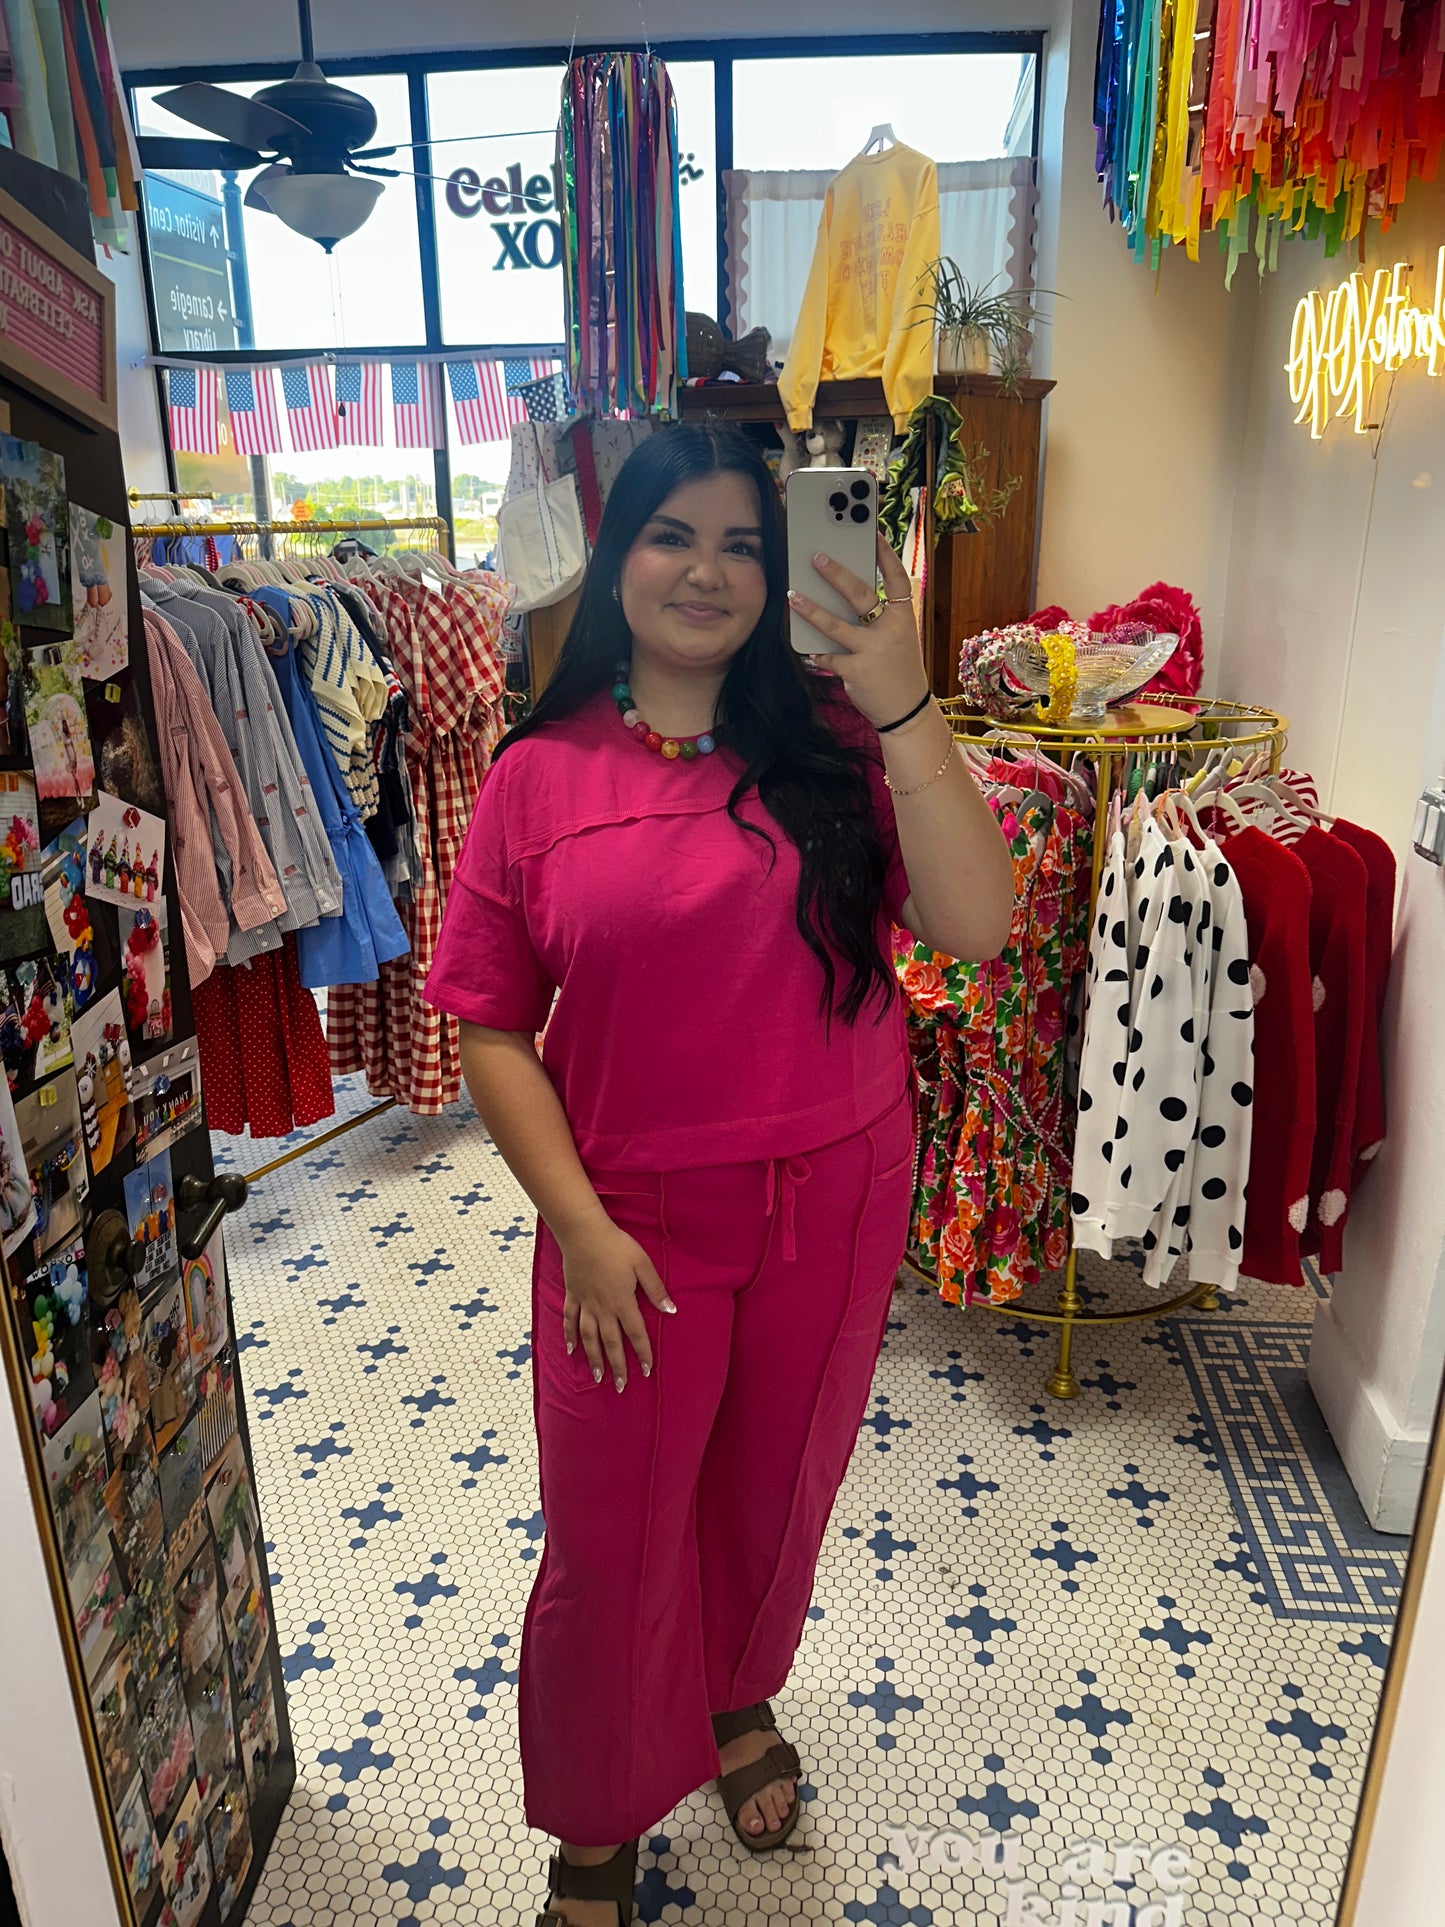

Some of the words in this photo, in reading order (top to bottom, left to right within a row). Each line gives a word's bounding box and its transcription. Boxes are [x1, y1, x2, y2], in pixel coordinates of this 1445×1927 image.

[881, 1824, 1026, 1875] you
[1061, 1838, 1192, 1885] are
[1004, 1878, 1185, 1927] kind
